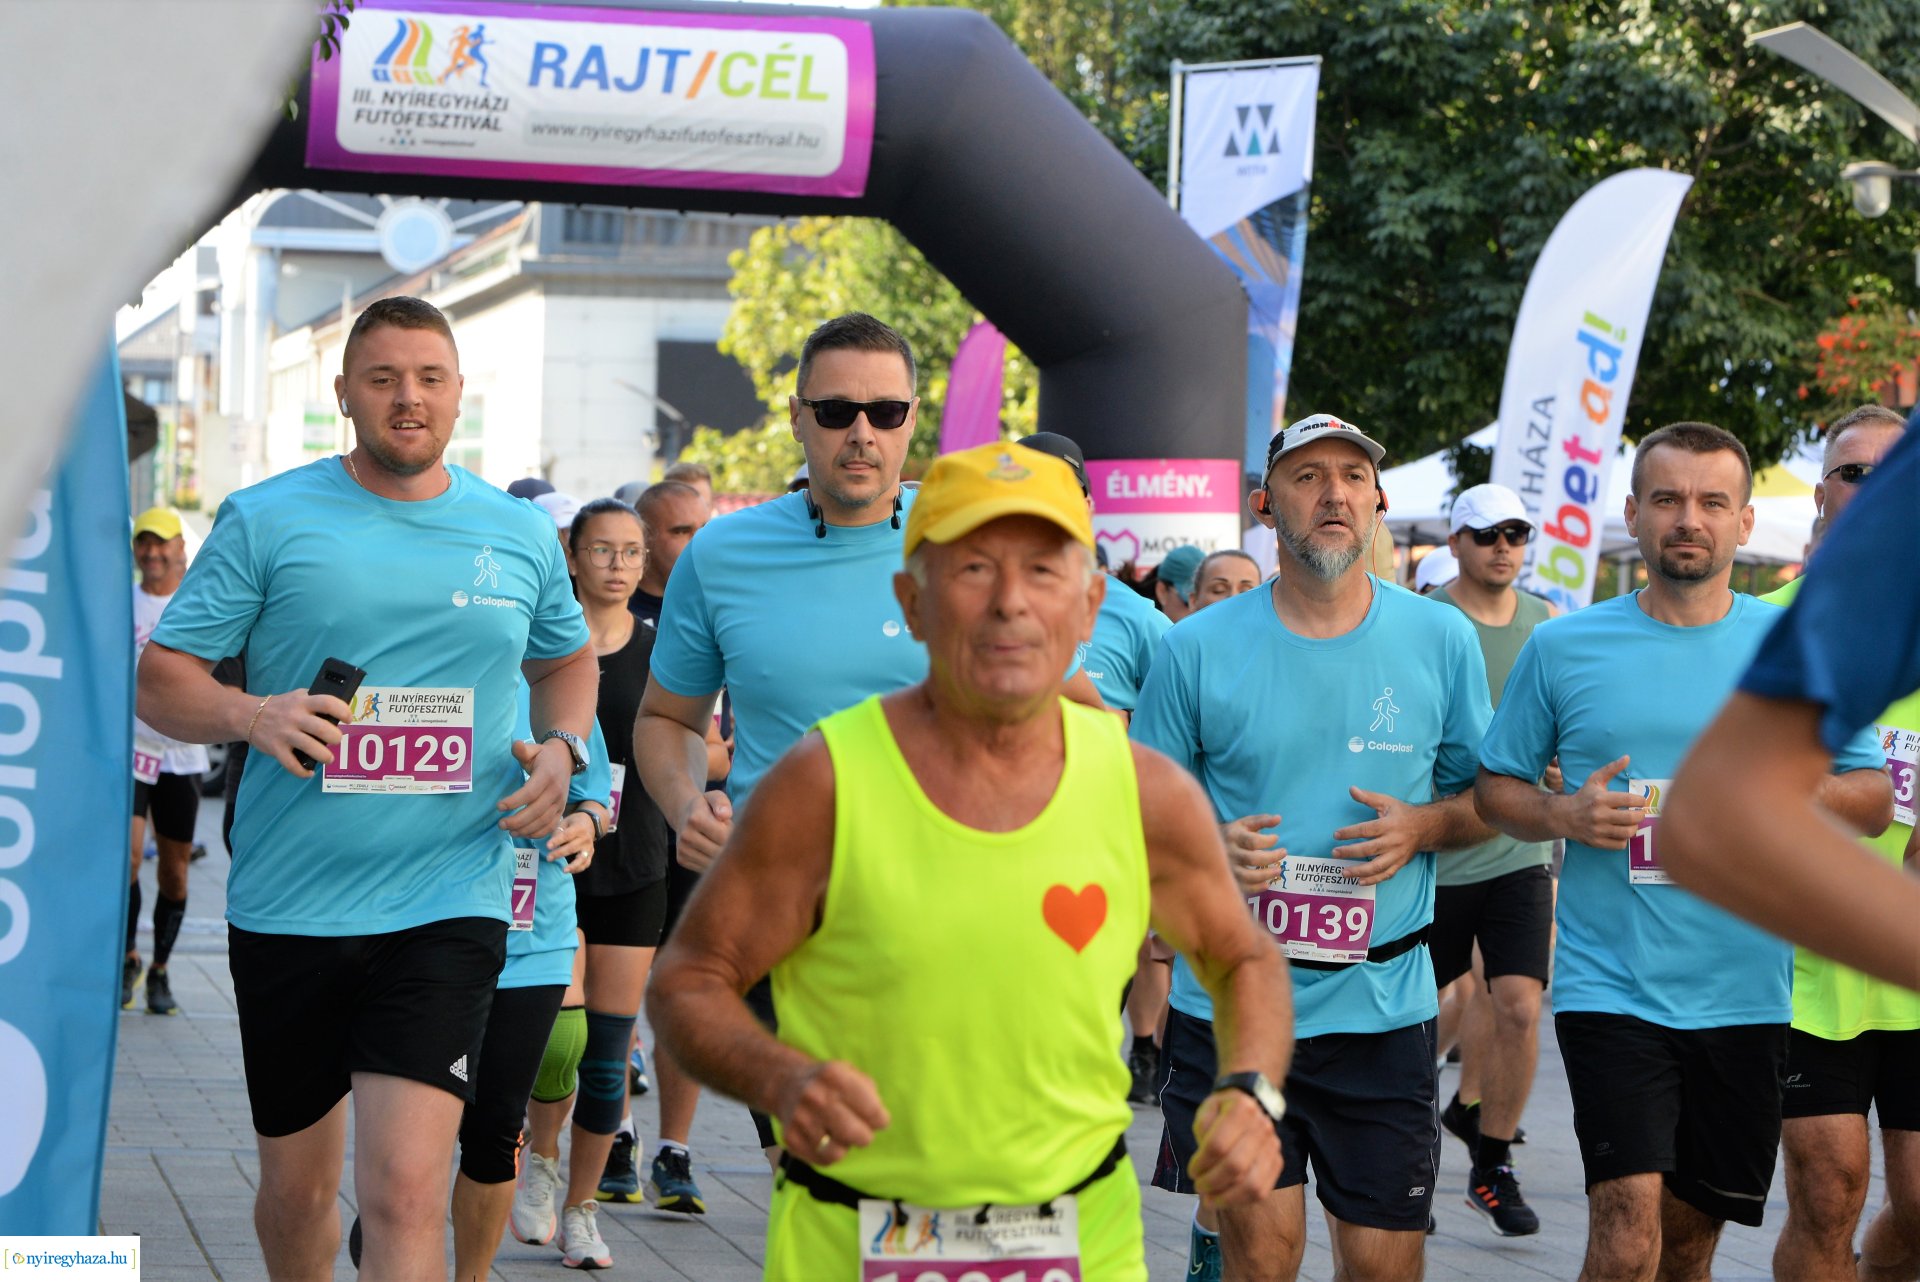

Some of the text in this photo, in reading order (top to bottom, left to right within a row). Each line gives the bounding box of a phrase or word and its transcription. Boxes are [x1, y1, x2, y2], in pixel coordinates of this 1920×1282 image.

[528, 41, 829, 101] RAJT/CÉL
[381, 88, 509, 111] NYÍREGYHÁZI
[354, 107, 503, 132] FUTÓFESZTIVÁL
[530, 121, 820, 149] www.nyiregyhazifutofesztival.hu
[1106, 468, 1213, 499] ÉLMÉNY.
[473, 595, 516, 608] Coloplast
[388, 703, 463, 714] FUTÓFESZTIVÁL
[339, 733, 467, 772] 10129
[1367, 740, 1414, 753] Coloplast
[1635, 825, 1652, 862] 1
[513, 885, 533, 913] 7
